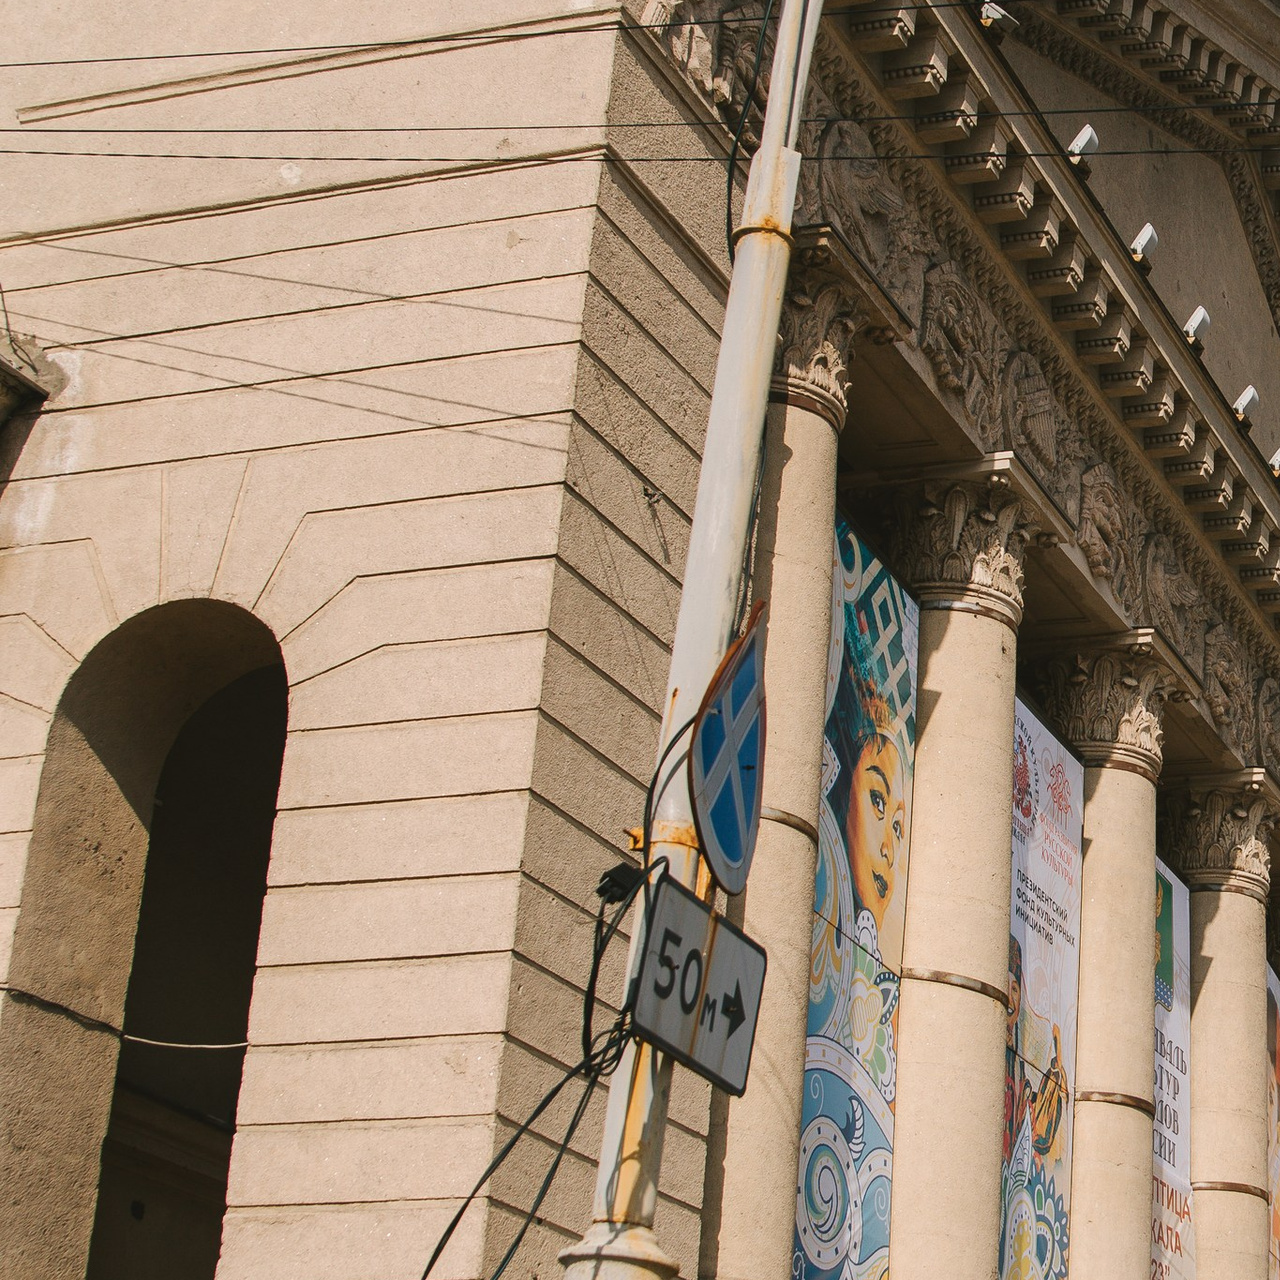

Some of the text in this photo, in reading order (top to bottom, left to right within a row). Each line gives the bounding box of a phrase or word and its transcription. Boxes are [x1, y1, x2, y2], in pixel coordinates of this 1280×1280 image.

[1041, 845, 1073, 887] КУЛЬТУРЫ
[1044, 830, 1073, 869] РУССКОЙ
[1016, 868, 1068, 923] ПРЕЗИДЕНТСКИЙ
[1016, 887, 1075, 947] ФОНД КУЛЬТУРНЫХ
[1015, 904, 1054, 946] ИНИЦИАТИВ
[1154, 1093, 1179, 1136] ДОВ
[1152, 1175, 1192, 1224] ПТИЦА
